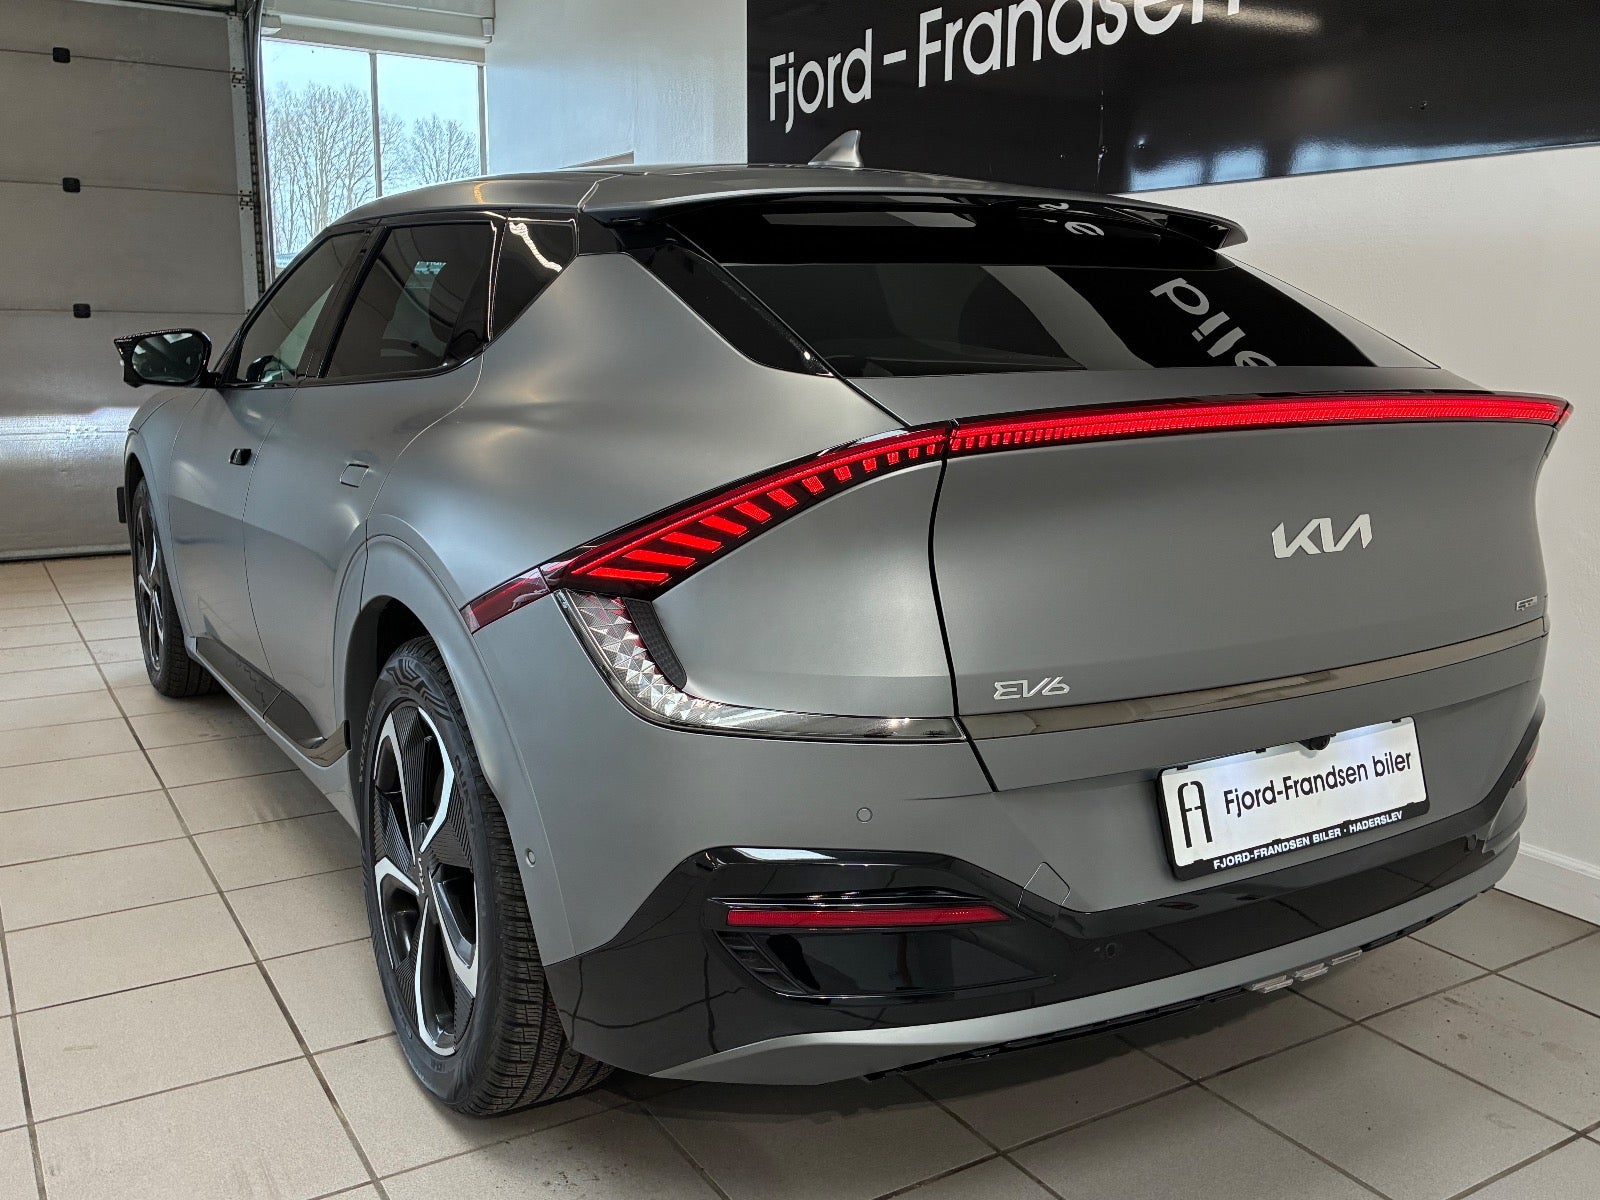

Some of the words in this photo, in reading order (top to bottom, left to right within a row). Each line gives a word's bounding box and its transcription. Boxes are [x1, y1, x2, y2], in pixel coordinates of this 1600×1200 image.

[1272, 513, 1372, 559] KIA
[994, 676, 1070, 700] EV6
[1223, 763, 1369, 817] Fjord-Frandsen
[1372, 752, 1411, 779] biler
[1213, 837, 1310, 870] FJORD-FRANDSEN
[1312, 827, 1341, 844] BILER
[1349, 811, 1403, 834] HADERSLEV
